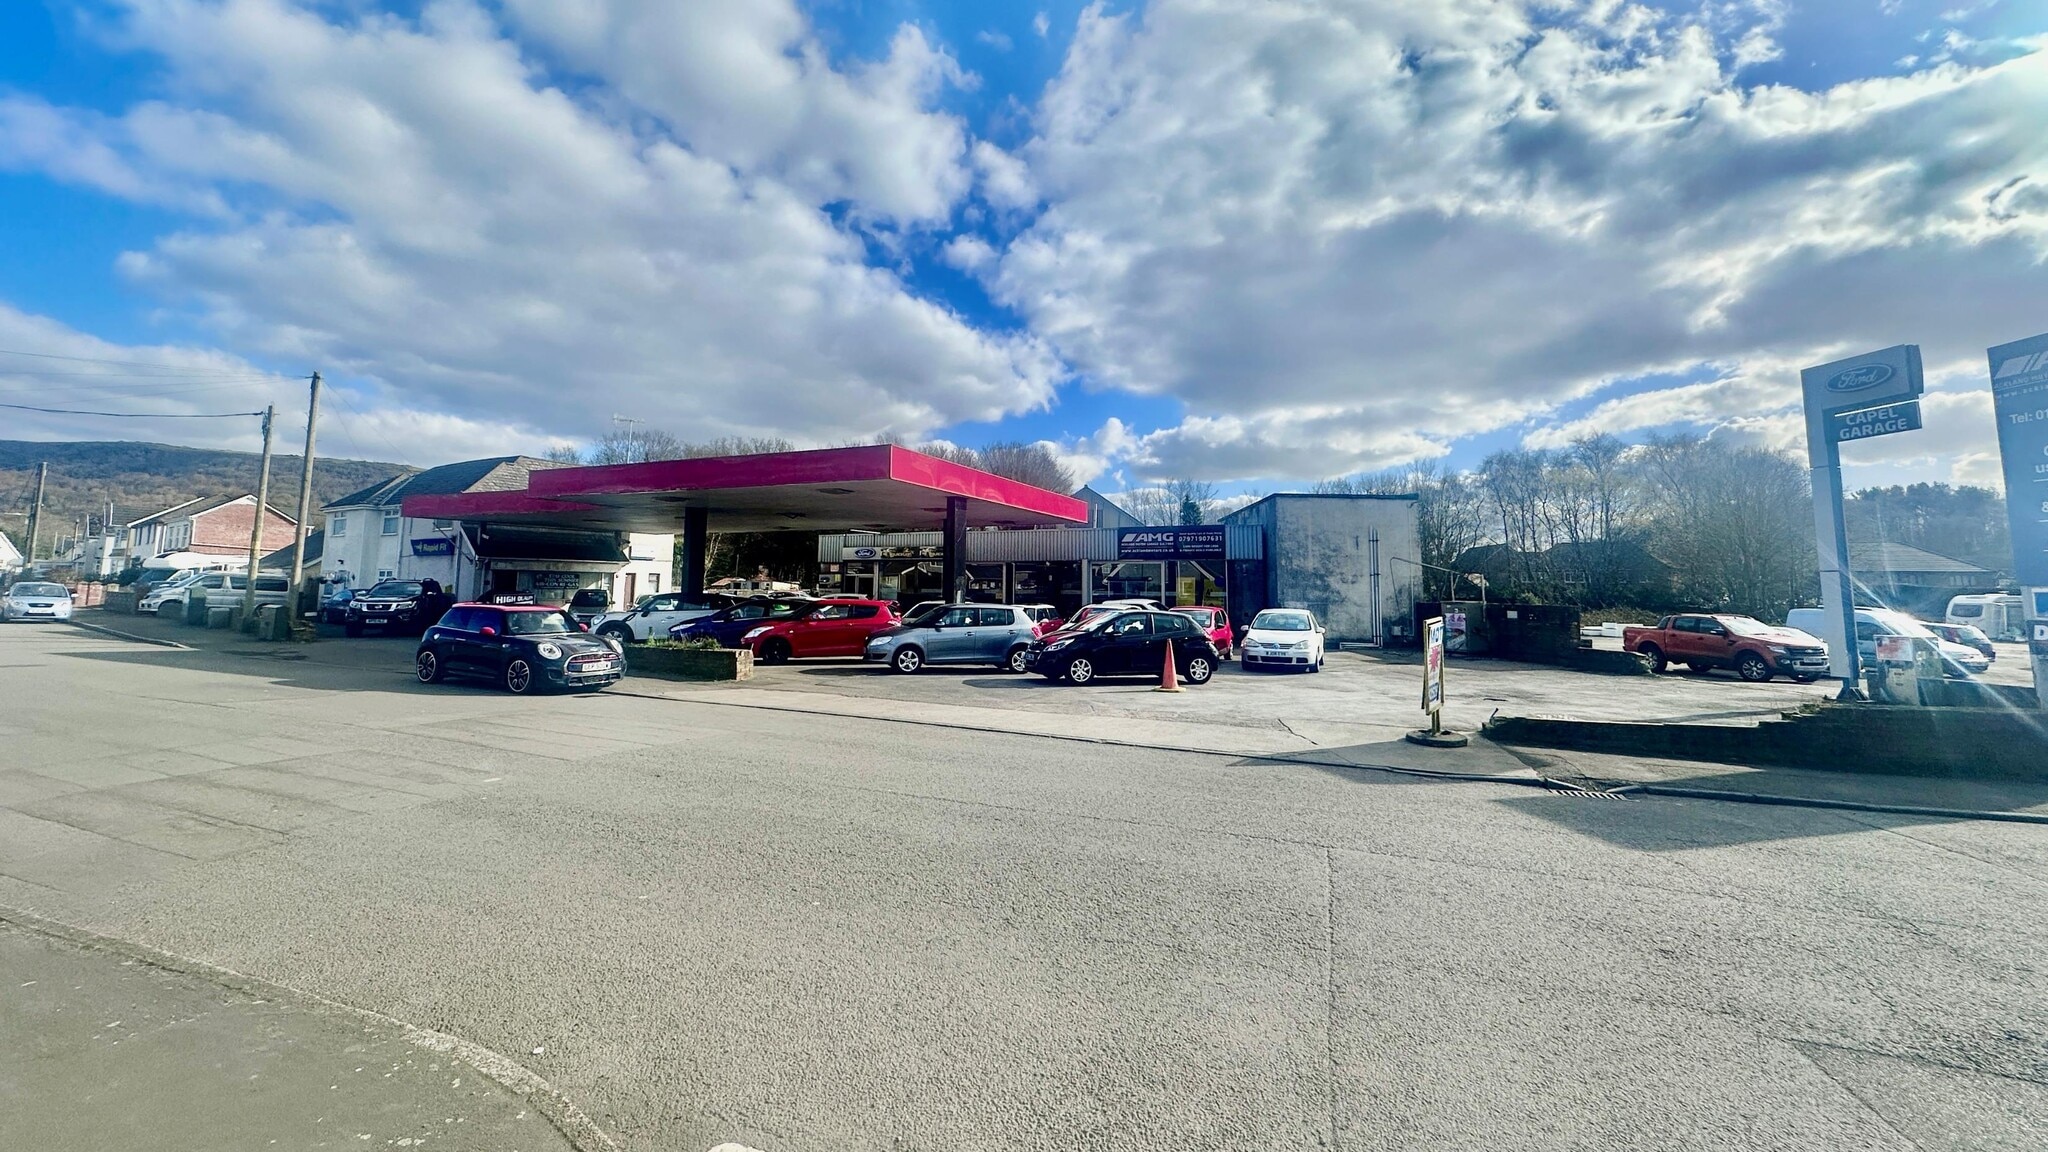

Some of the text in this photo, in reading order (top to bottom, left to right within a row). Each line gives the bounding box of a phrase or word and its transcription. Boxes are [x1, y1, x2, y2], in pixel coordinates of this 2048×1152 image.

[1838, 368, 1878, 389] Ford
[1846, 408, 1898, 425] CAPEL
[2009, 412, 2033, 424] Tel:
[1840, 419, 1907, 439] GARAGE
[1135, 533, 1174, 542] AMG
[496, 595, 516, 604] HIGH
